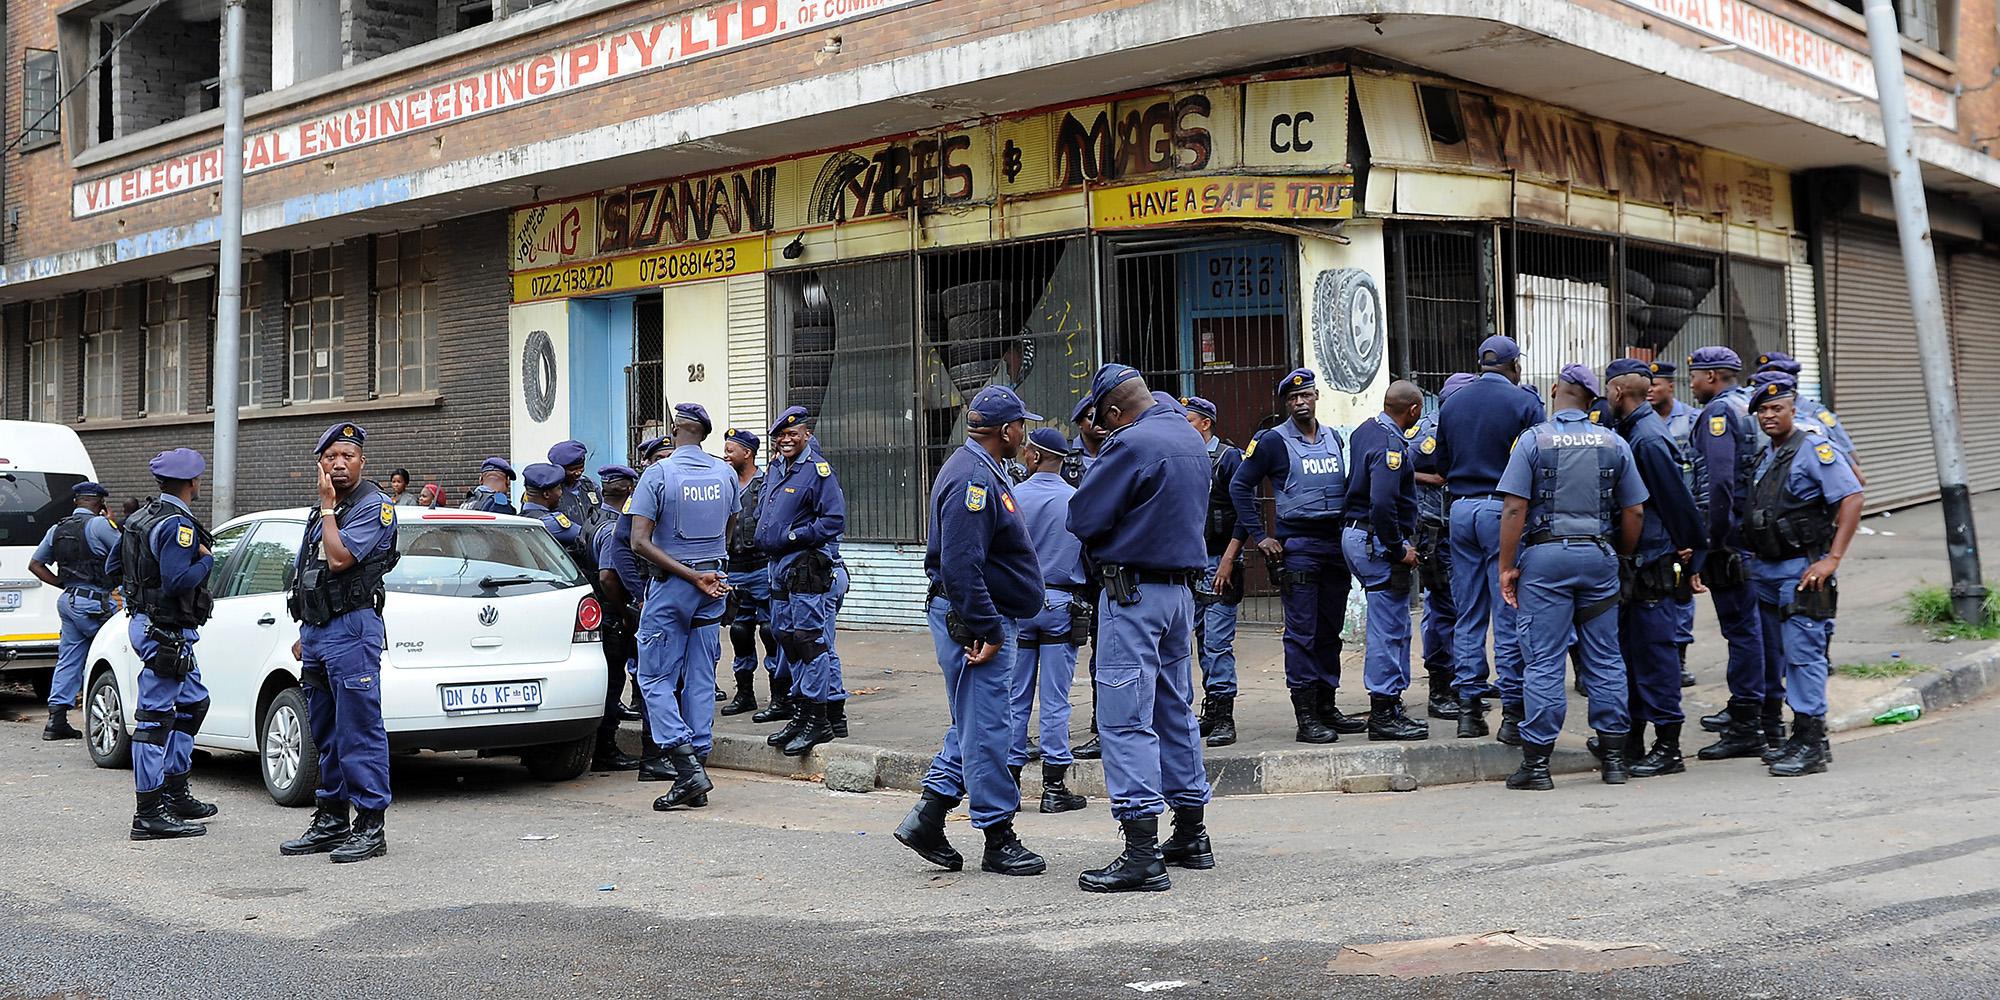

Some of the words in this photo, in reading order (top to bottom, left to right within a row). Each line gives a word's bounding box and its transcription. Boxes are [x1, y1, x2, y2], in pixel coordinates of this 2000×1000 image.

[121, 133, 289, 202] ELECTRIAL
[300, 57, 555, 156] ENGINEERING
[1055, 94, 1212, 189] MAGS
[1271, 111, 1315, 153] CC
[1129, 188, 1179, 219] HAVE
[1184, 189, 1198, 213] A
[1201, 184, 1276, 214] SAFE
[517, 234, 533, 264] YOU
[531, 260, 613, 297] 0722938220
[640, 246, 736, 283] 0730881433
[1209, 257, 1283, 277] 0722
[1552, 433, 1604, 447] POLICE
[1301, 457, 1340, 475] POLICE
[683, 483, 721, 502] POLICE
[395, 640, 425, 649] POLO
[446, 689, 463, 706] DN
[472, 687, 488, 704] 66
[495, 686, 511, 703] KF
[522, 685, 538, 702] GP
